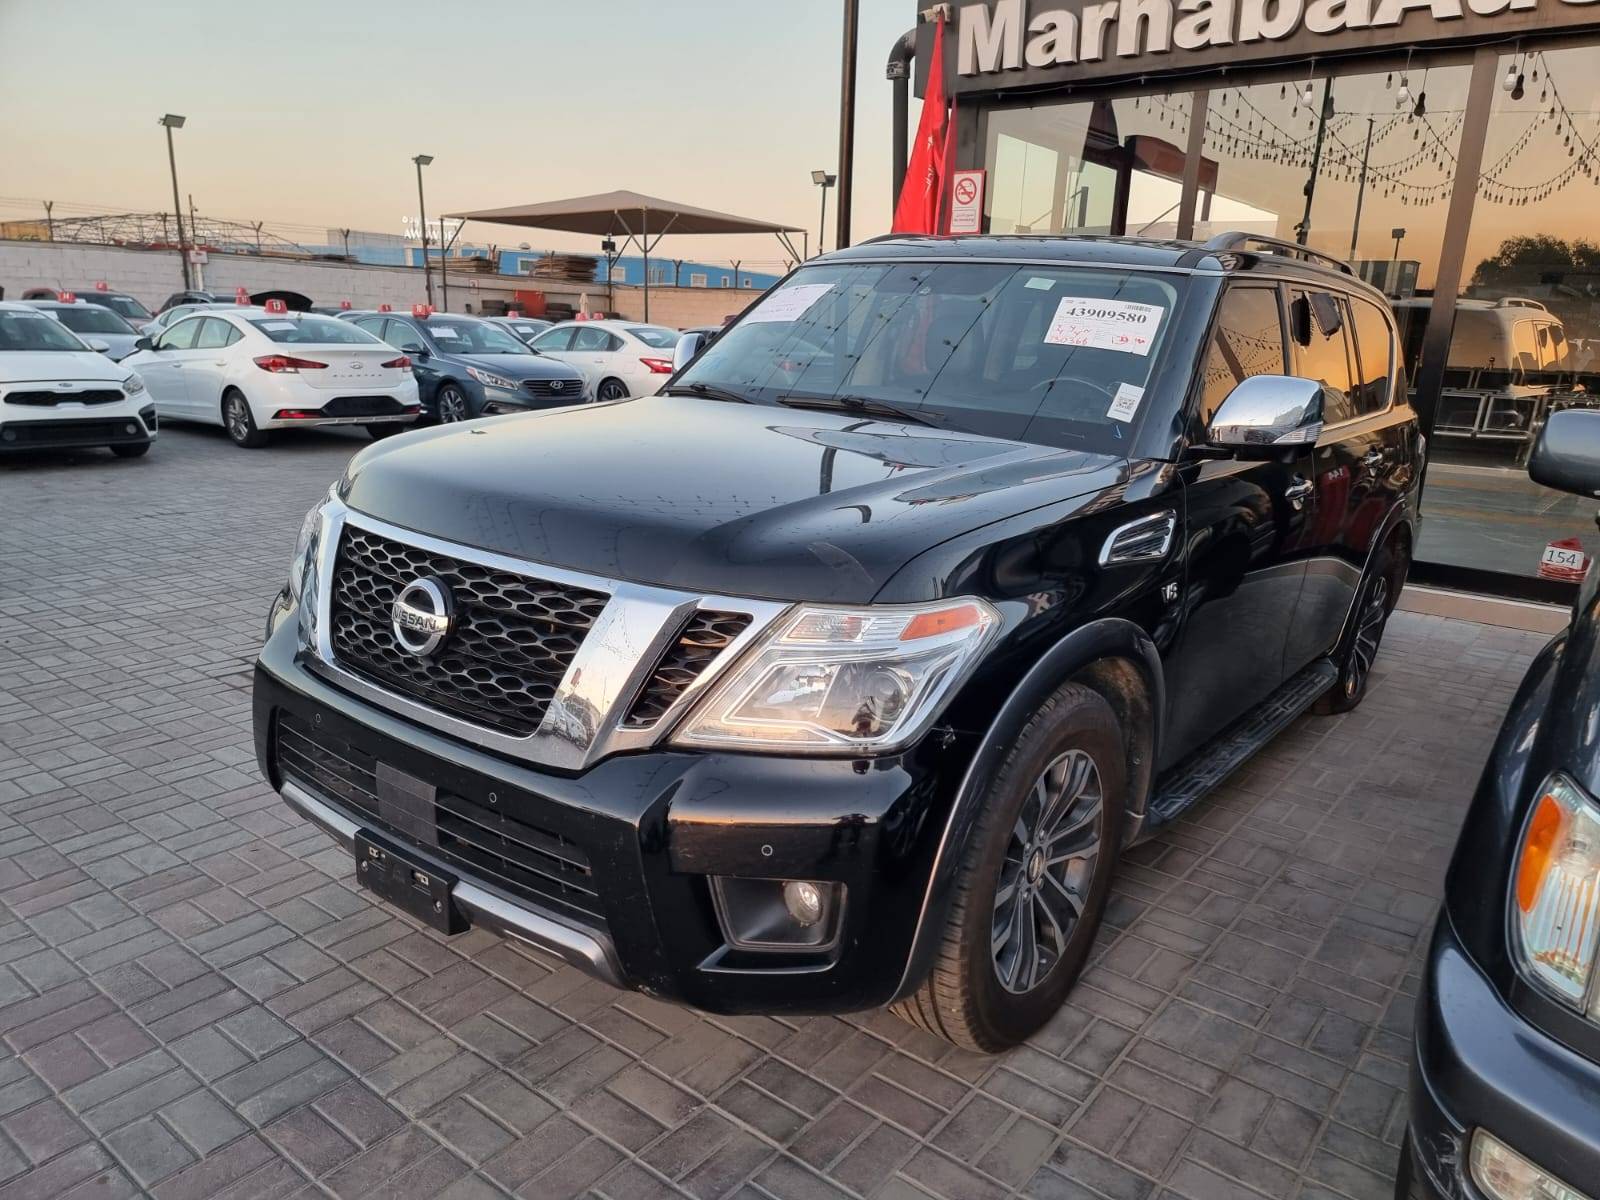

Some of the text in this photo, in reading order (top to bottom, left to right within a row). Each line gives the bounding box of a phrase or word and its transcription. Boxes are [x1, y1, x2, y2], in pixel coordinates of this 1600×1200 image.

[1066, 307, 1147, 324] 43909580
[1546, 549, 1577, 566] 154
[393, 603, 437, 630] NISSAN
